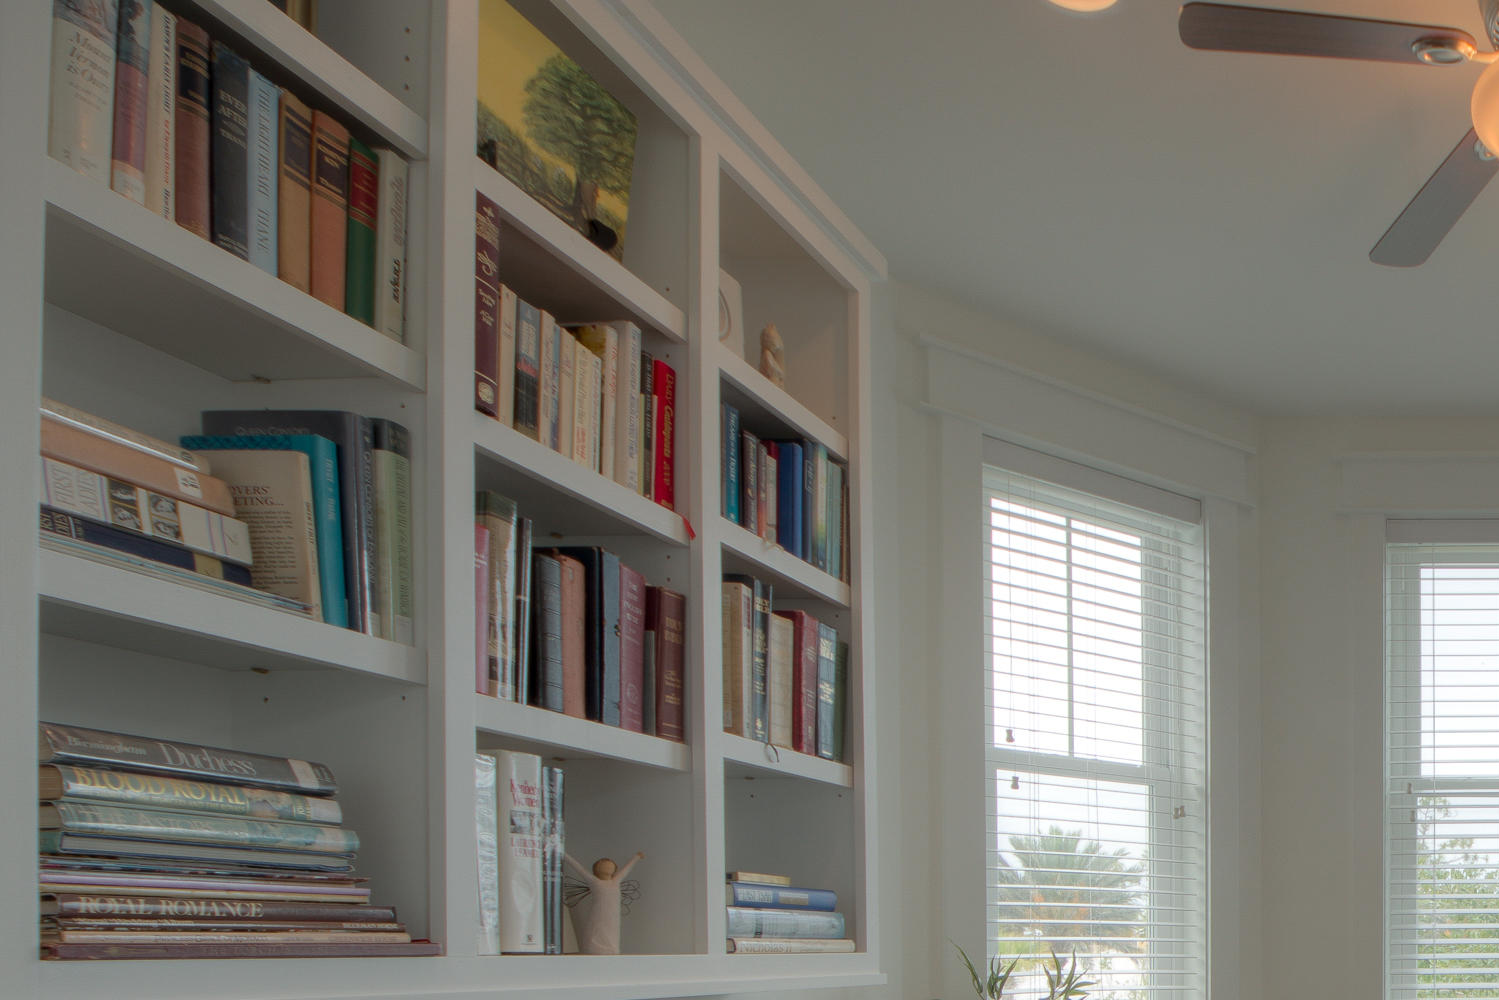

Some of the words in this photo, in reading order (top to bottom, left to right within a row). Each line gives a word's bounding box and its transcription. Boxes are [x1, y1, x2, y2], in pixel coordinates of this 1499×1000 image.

[217, 104, 249, 129] AFTER
[218, 88, 249, 114] EVER
[256, 153, 271, 200] HEART
[256, 208, 271, 253] THANE
[233, 496, 285, 506] ETING...
[66, 734, 148, 758] Birmingham
[158, 742, 258, 777] Duchess
[74, 765, 166, 795] BLOOD
[174, 778, 248, 806] ROYAL
[79, 896, 154, 915] ROYAL
[160, 899, 266, 918] ROMANCE
